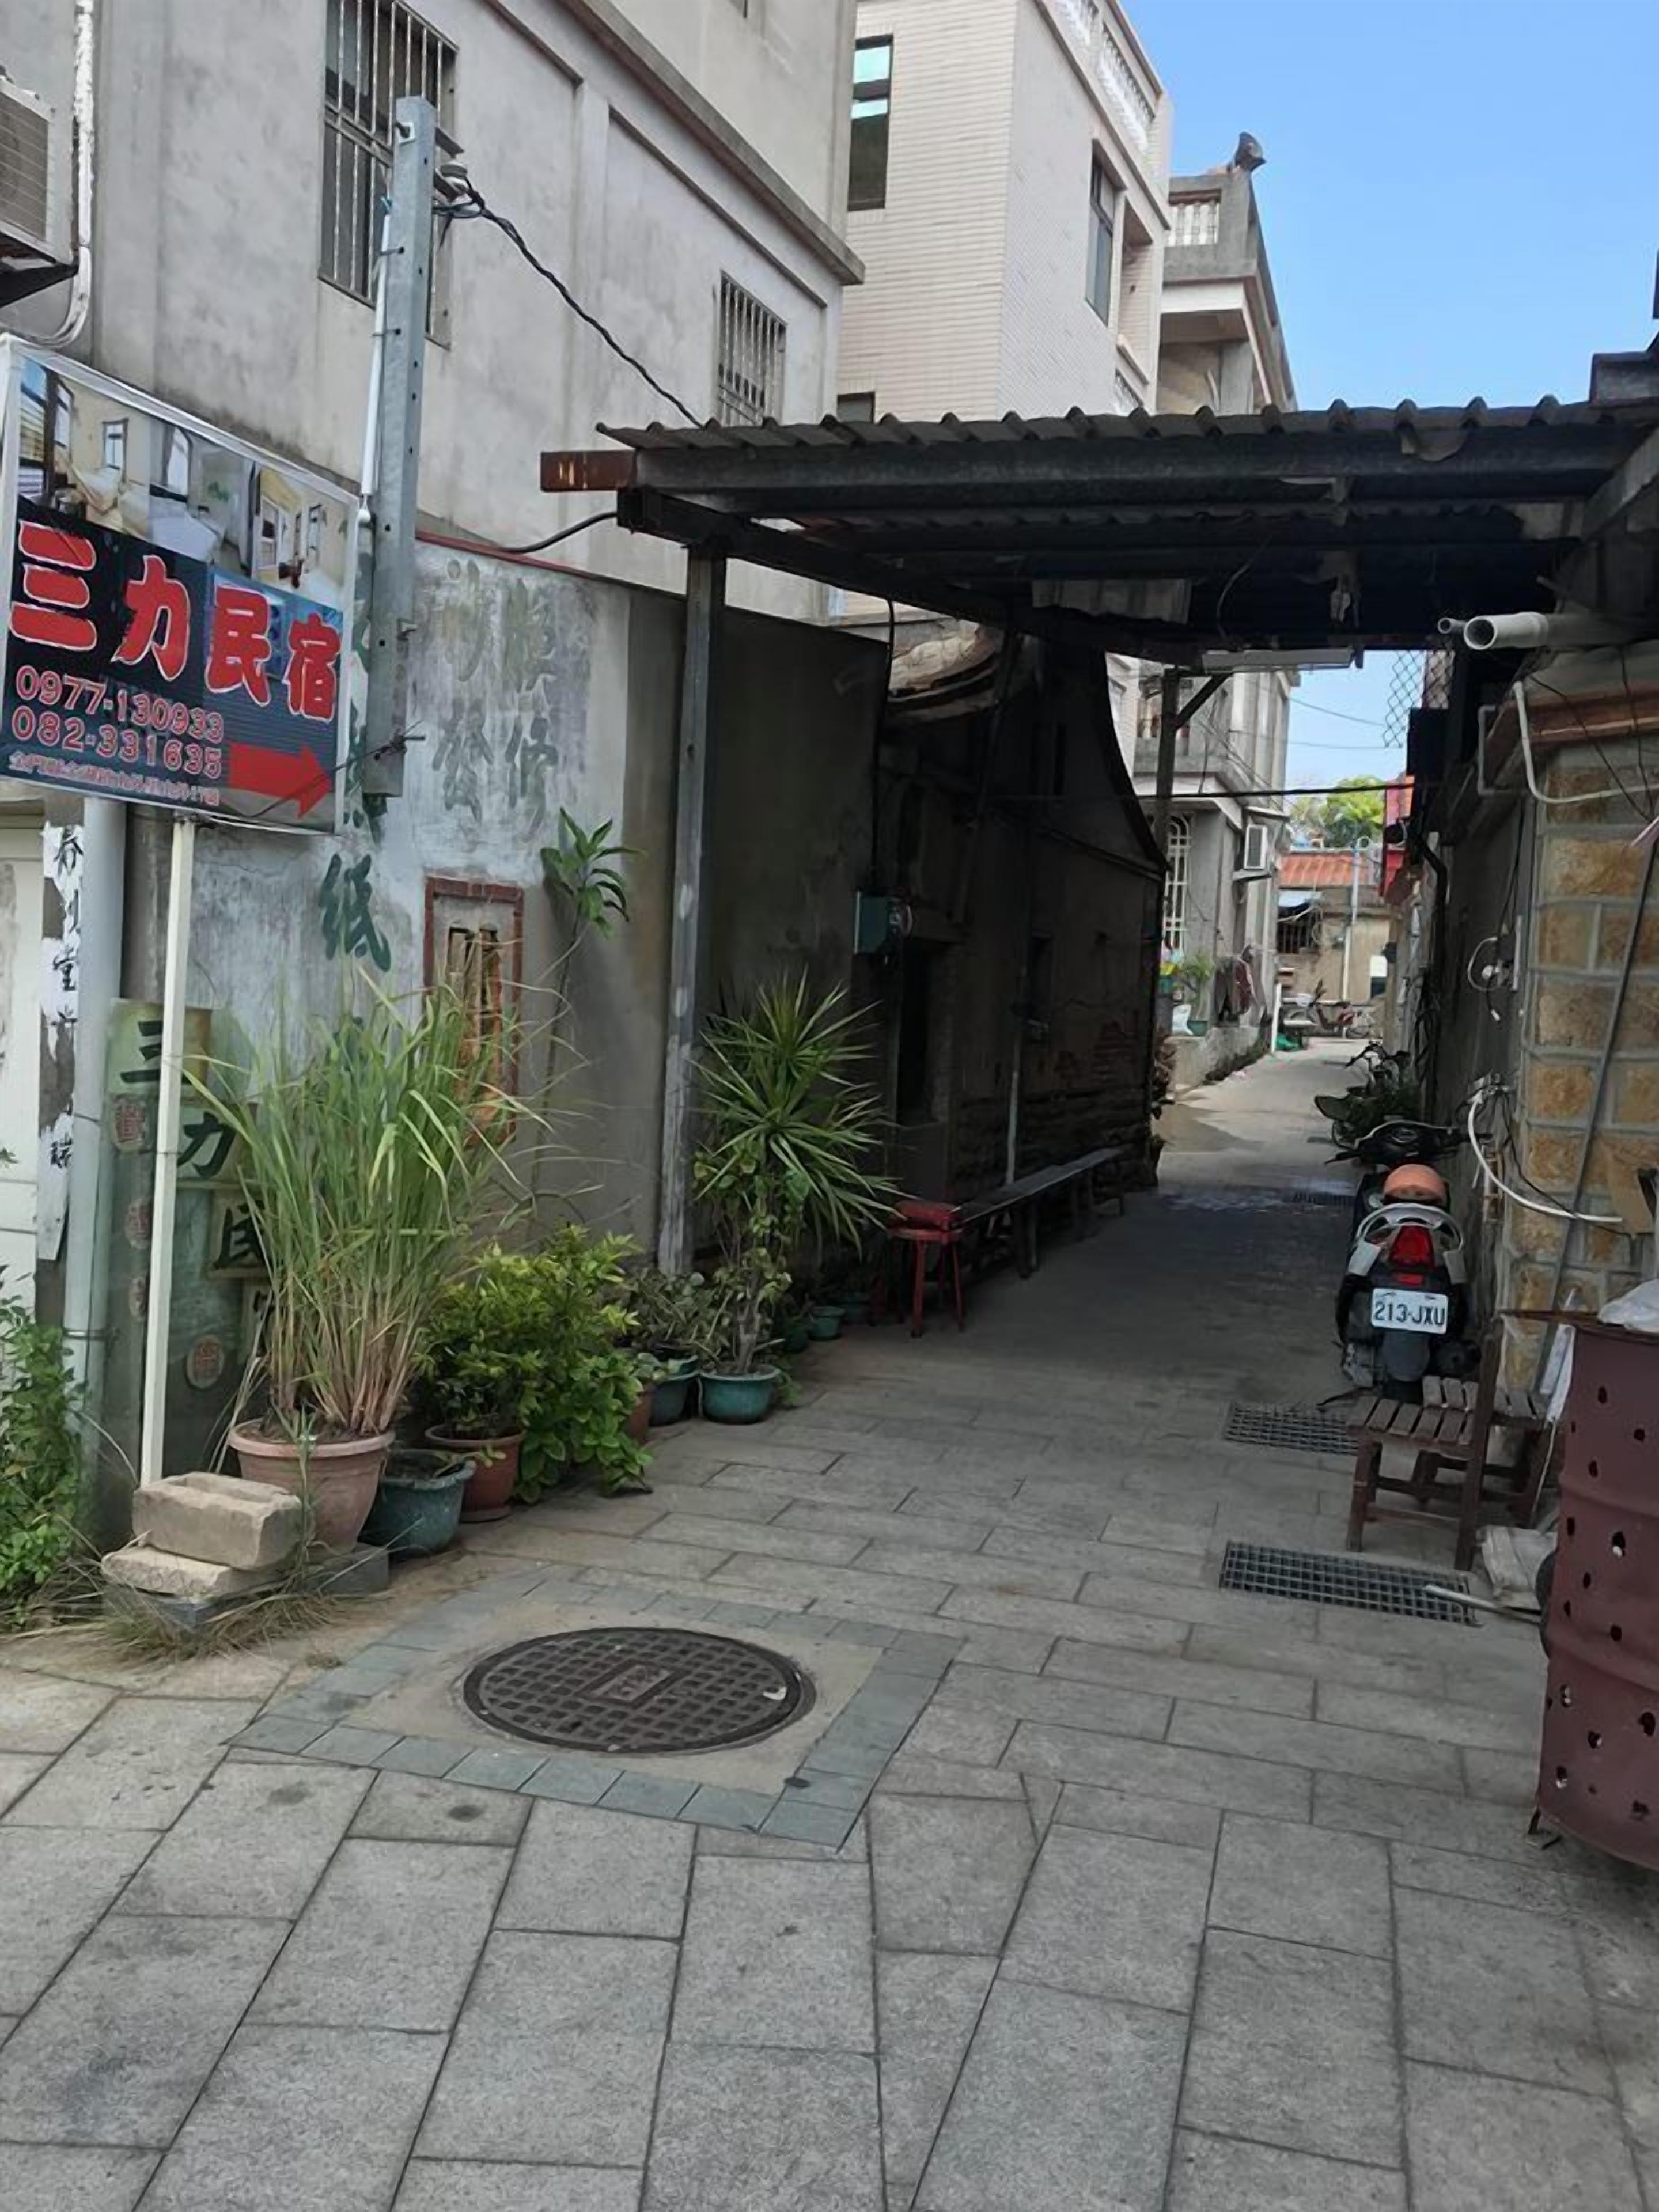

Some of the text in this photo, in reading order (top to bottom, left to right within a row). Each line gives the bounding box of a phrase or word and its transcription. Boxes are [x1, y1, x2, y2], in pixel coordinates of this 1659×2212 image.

[9, 518, 342, 723] 三力民宿
[11, 705, 222, 779] 082-331635
[16, 664, 225, 745] 0977-130933
[1374, 1301, 1445, 1327] 213-JXU
